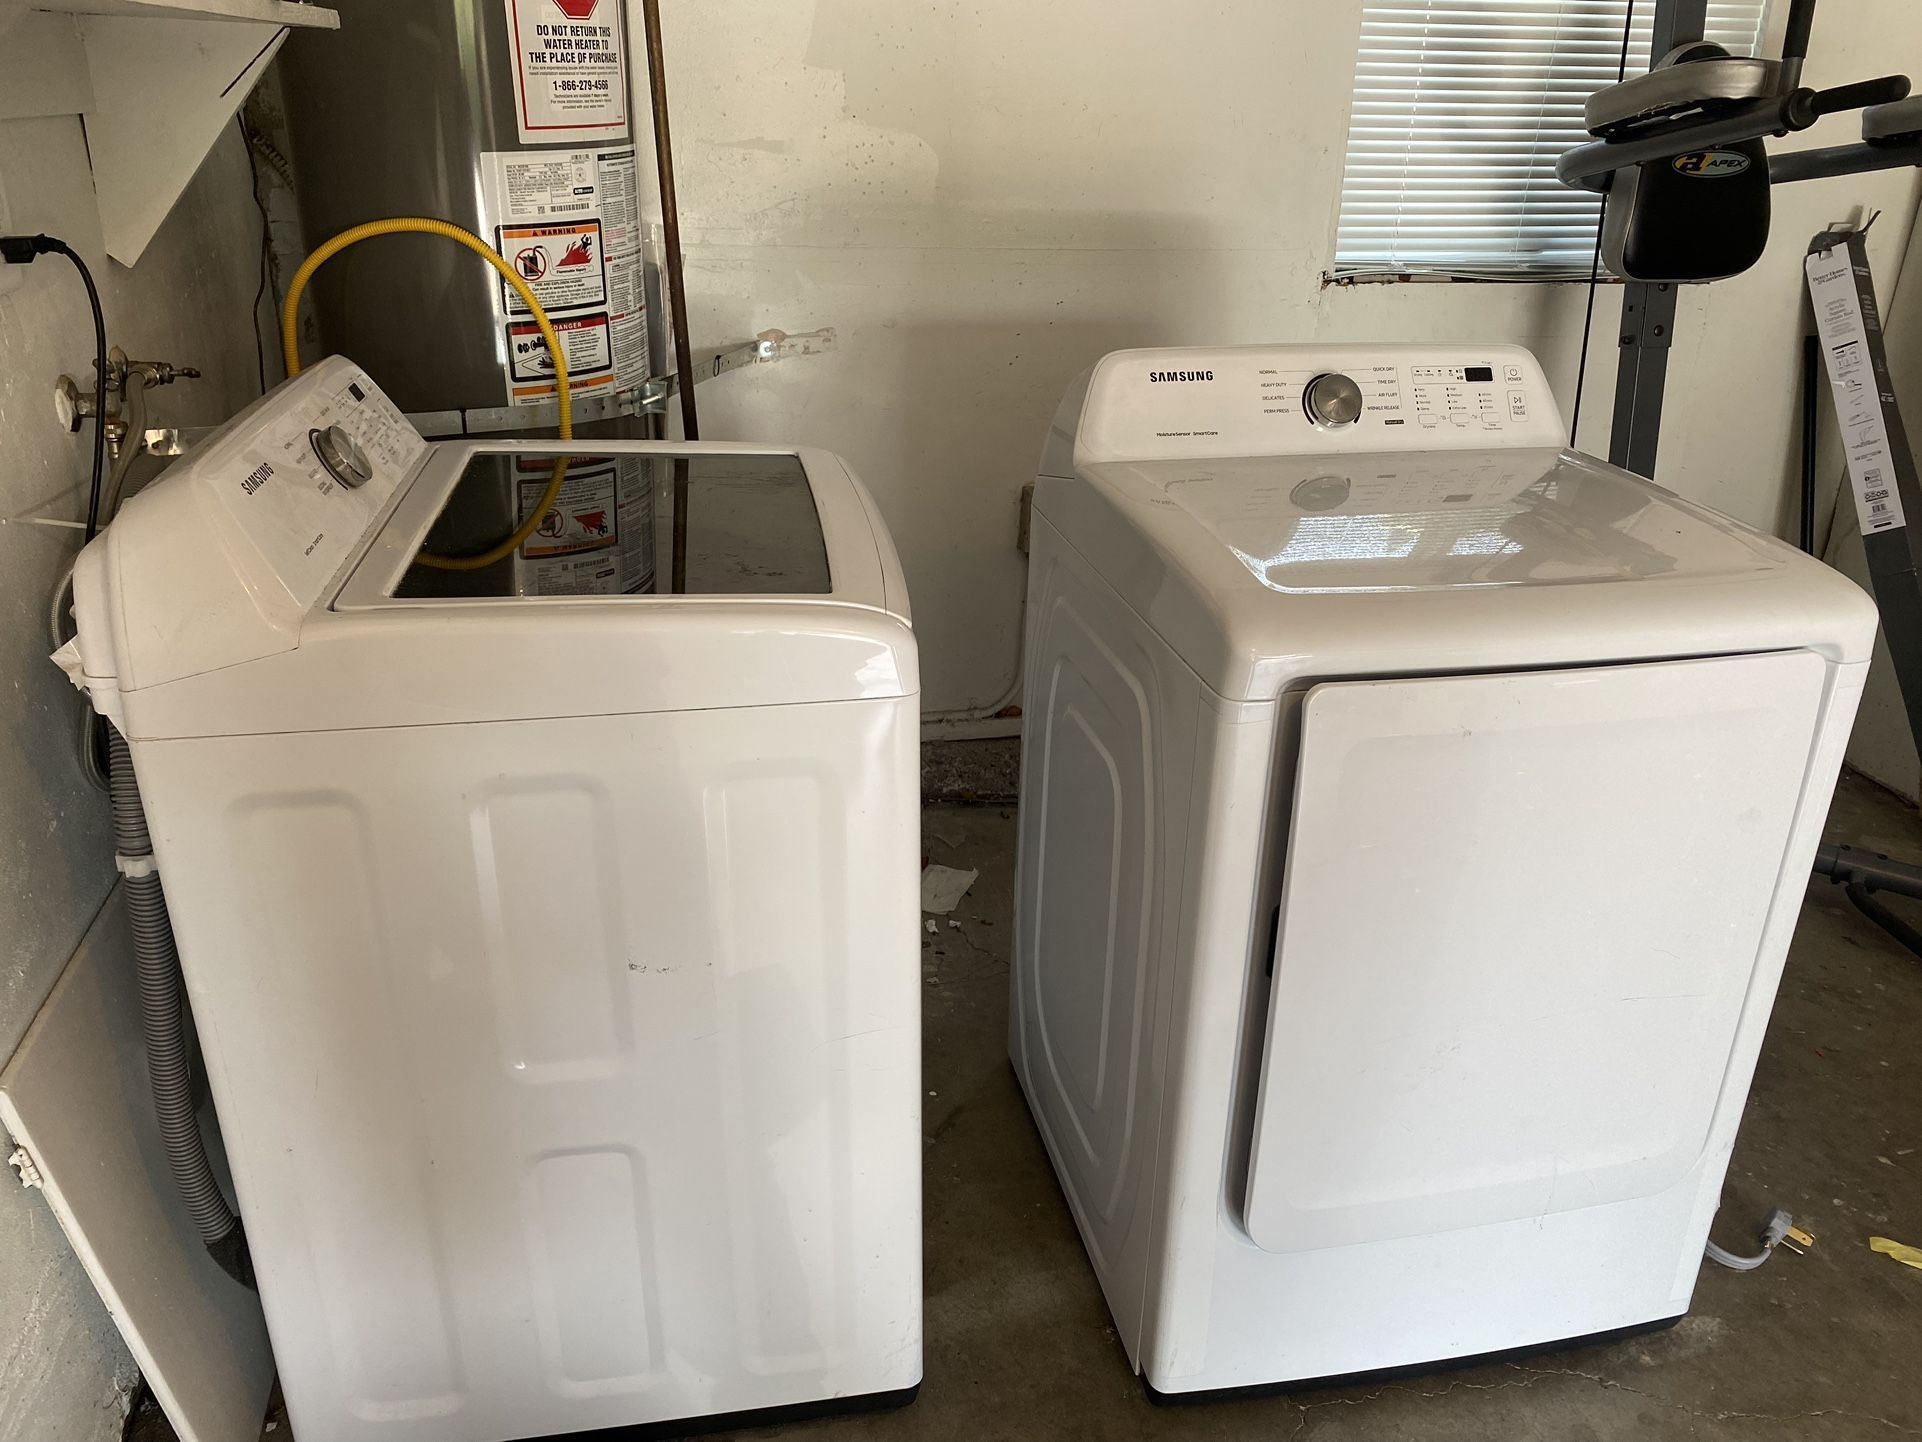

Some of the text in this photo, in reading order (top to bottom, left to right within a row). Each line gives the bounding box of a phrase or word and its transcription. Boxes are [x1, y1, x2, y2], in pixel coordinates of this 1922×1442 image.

[536, 24, 611, 37] DO NOT RETURN THIS
[543, 38, 609, 50] WATER HEATER TO
[528, 52, 618, 64] THE PLACE OF PURCHASE
[552, 80, 609, 91] 1-866-279-4566
[1705, 159, 1747, 168] APEX
[540, 228, 576, 236] WARNING
[553, 322, 582, 331] DANGER
[1149, 370, 1214, 383] SAMSUNG
[240, 462, 275, 496] SAMSUNG
